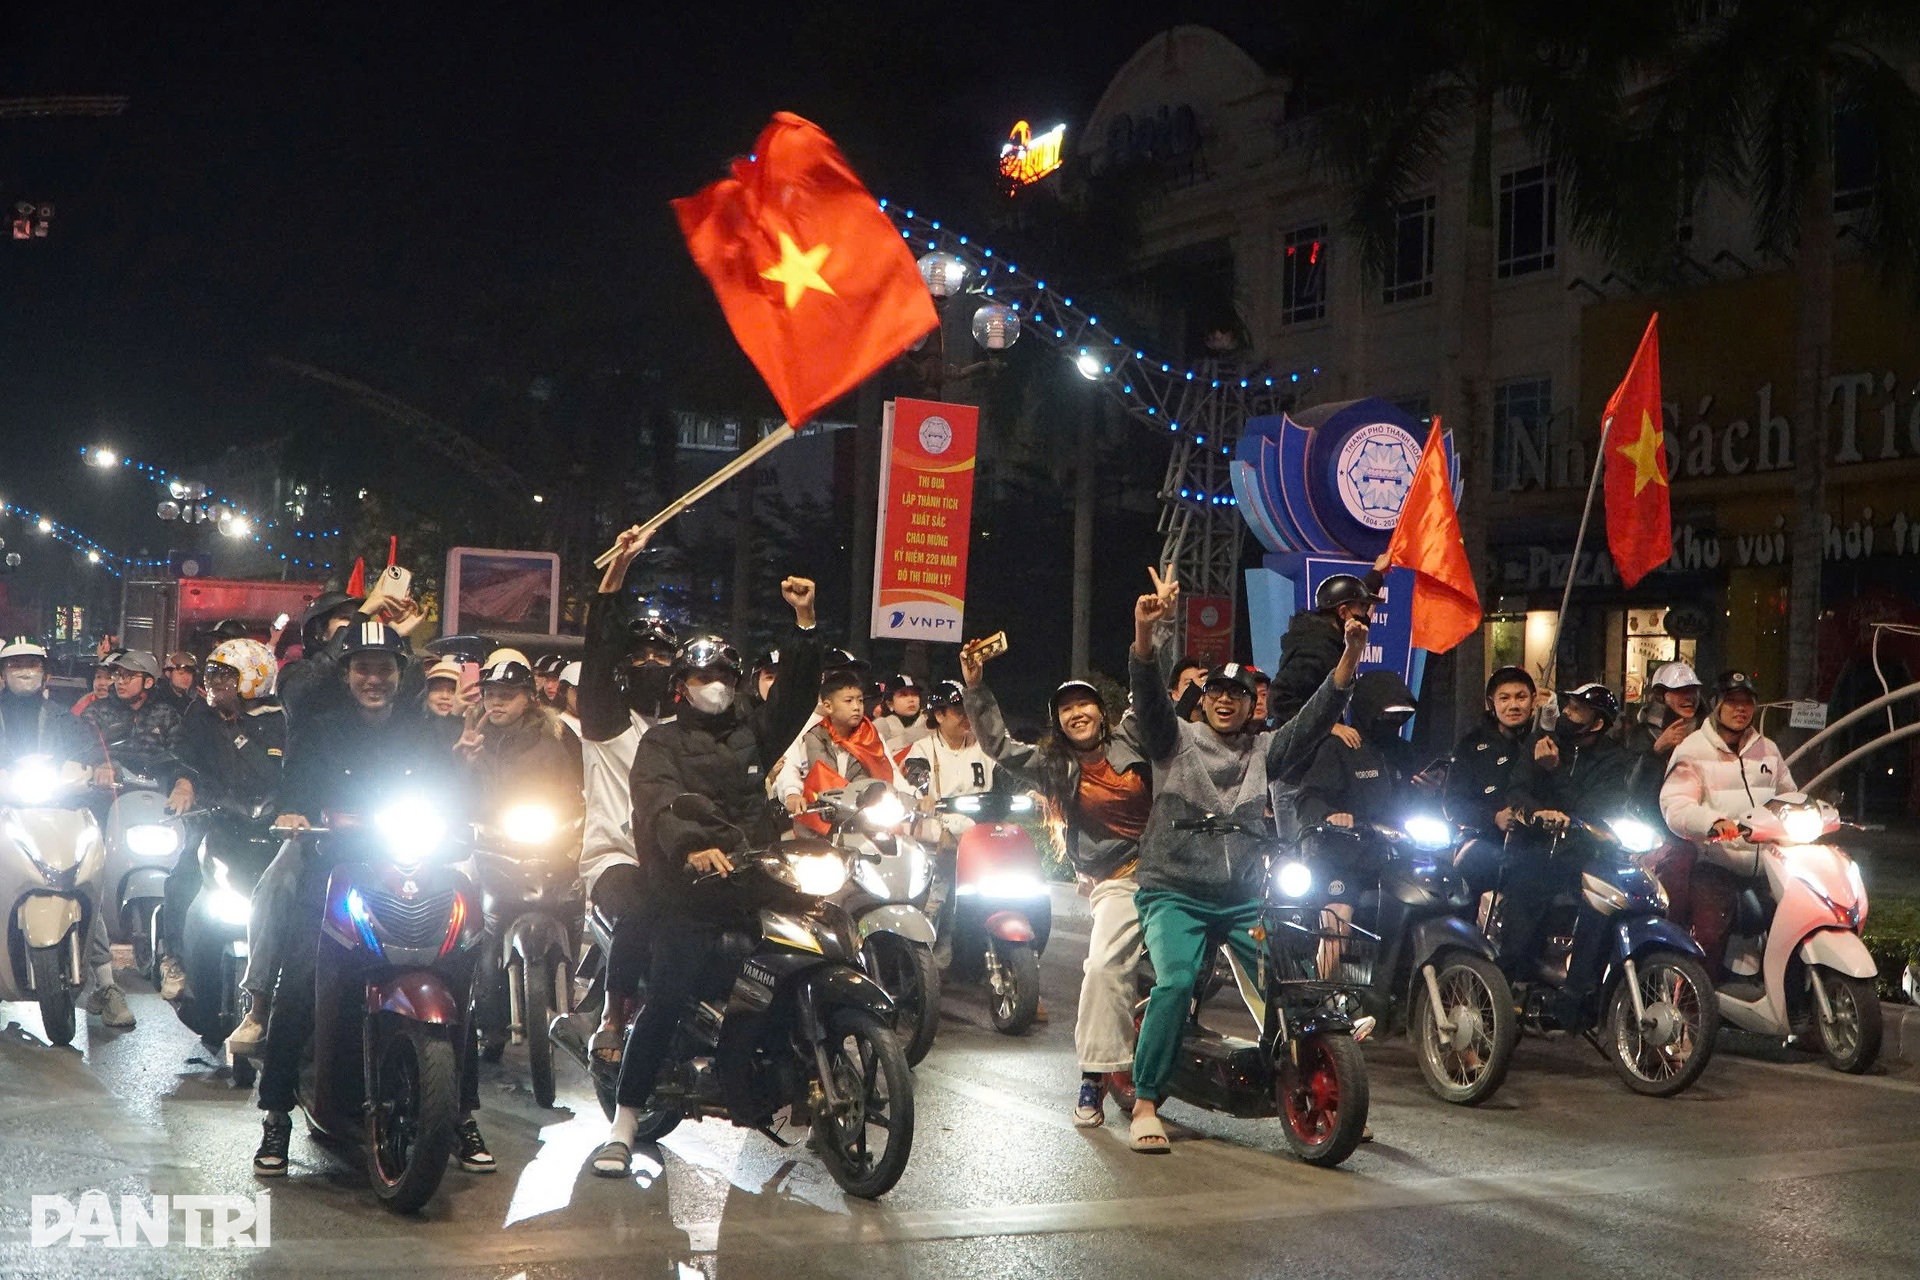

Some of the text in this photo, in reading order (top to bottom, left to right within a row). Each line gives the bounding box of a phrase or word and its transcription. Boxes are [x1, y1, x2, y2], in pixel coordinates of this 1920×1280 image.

[1386, 427, 1411, 444] THANH
[1736, 513, 1785, 566] vui
[925, 553, 939, 565] 220
[910, 616, 956, 629] VNPT
[971, 762, 985, 788] B
[743, 962, 775, 987] YAMAHA
